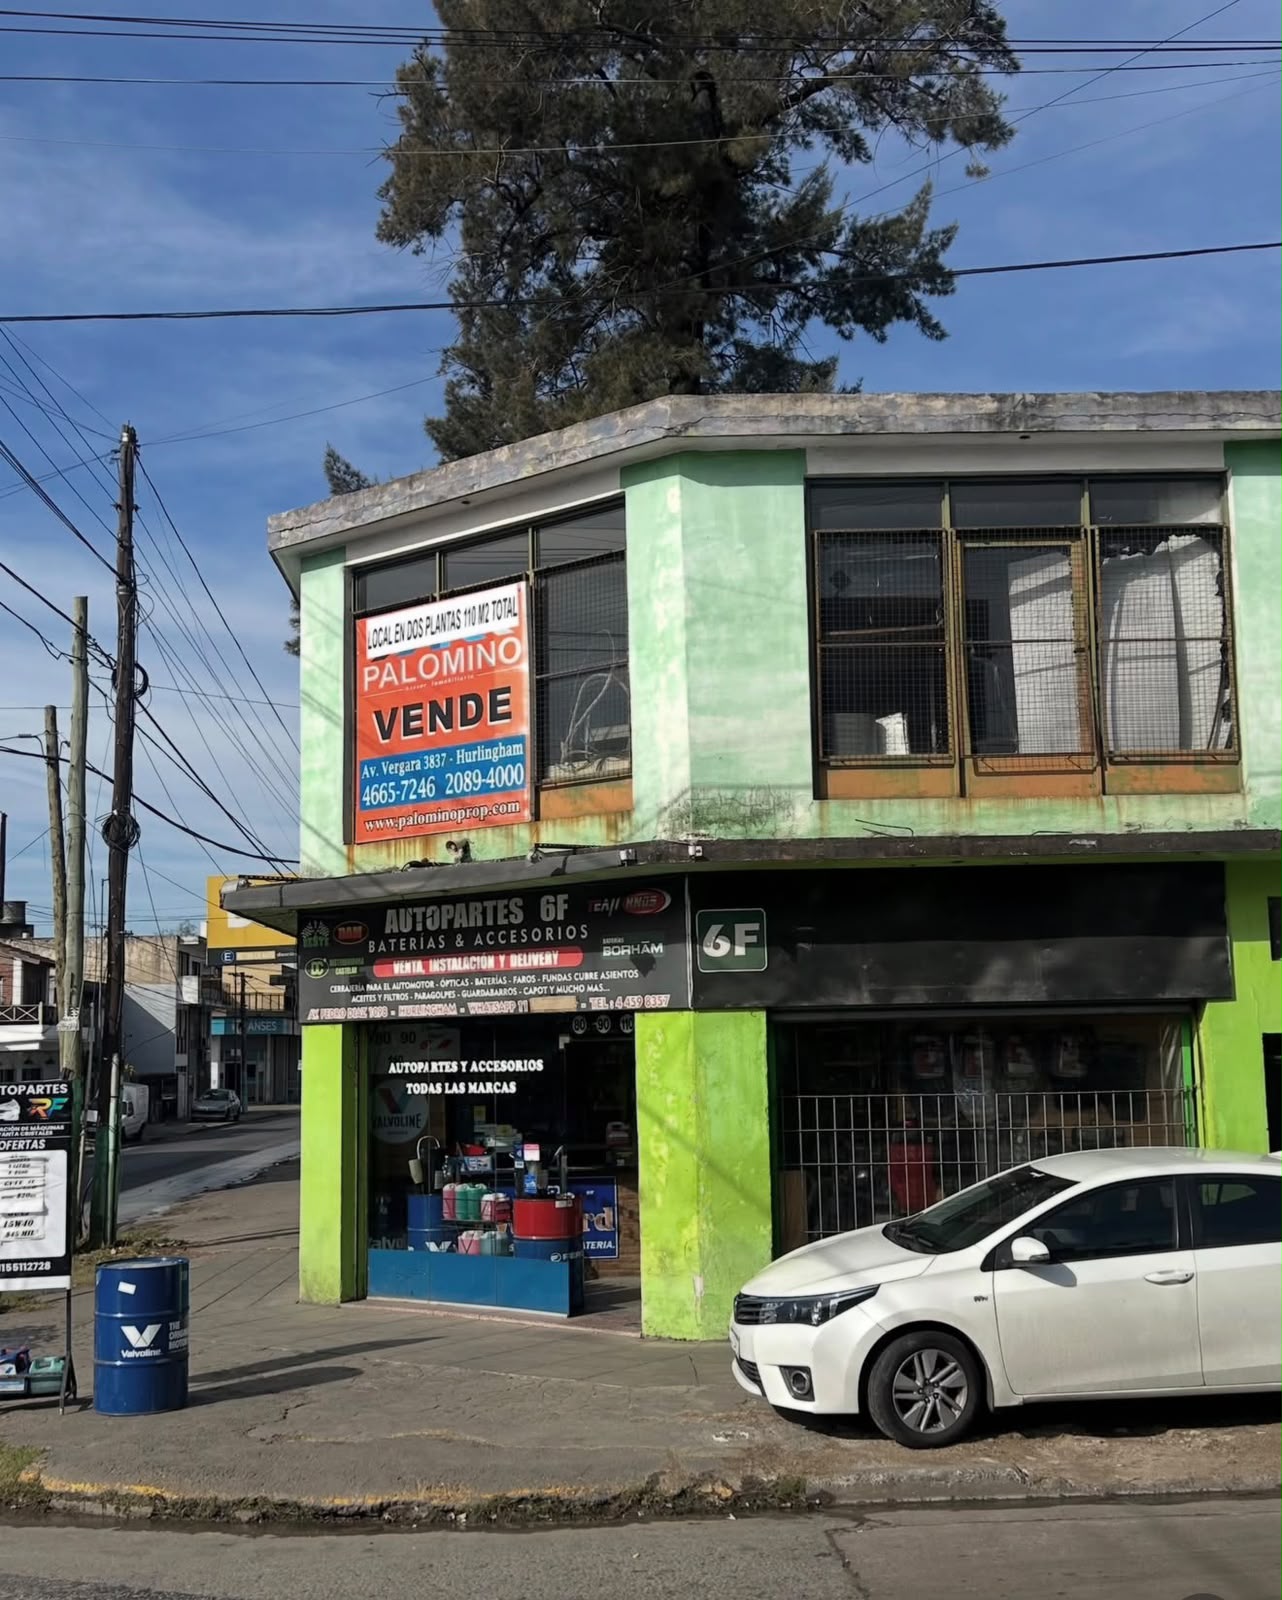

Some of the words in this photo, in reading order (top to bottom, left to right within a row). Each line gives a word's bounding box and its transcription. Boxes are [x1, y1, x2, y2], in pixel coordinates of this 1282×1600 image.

[368, 626, 392, 649] LOCAL
[394, 624, 405, 643] EN
[407, 618, 424, 640] DOS
[425, 609, 461, 638] PLANTAS
[464, 606, 476, 627] 110
[479, 604, 489, 625] M2
[492, 596, 518, 622] TOTAL
[363, 636, 522, 692] PALOMINO
[372, 686, 512, 743] VENDE
[361, 765, 379, 779] Av.
[381, 759, 421, 777] Vergara
[424, 753, 447, 770] 3837
[456, 743, 524, 765] Hurlingham
[362, 776, 436, 806] 4665-7246
[445, 763, 524, 795] 2089-4000
[364, 801, 520, 831] www.palominoprop.com
[384, 897, 524, 934] AUTOPARTES
[540, 894, 569, 922] 6F
[368, 932, 446, 953] BATERÍAS
[455, 934, 465, 947] &
[474, 924, 588, 946] ACCESORIOS
[702, 923, 760, 957] 6F
[429, 953, 495, 973] INSTALACIÓN
[499, 954, 506, 969] Y
[510, 950, 559, 969] DELIVERY
[351, 994, 376, 1003] ACEITES
[377, 993, 382, 1002] Y
[383, 992, 409, 1001] FILTROS
[414, 990, 456, 1000] PARAGOLPES
[461, 988, 517, 998] GUARDABARROS
[523, 986, 548, 995] CAPOT
[549, 985, 554, 994] Y
[556, 984, 585, 993] MUCHO
[366, 982, 382, 991] PARA
[383, 982, 391, 990] EL
[391, 980, 434, 990] AUTOMOTOR
[440, 978, 469, 988] ÓPTICAS
[474, 975, 507, 986] BATERÍAS
[513, 975, 536, 984] FAROS
[542, 973, 572, 982] FUNDAS
[573, 972, 598, 981] CUBRE
[600, 969, 639, 980] ASIENTOS
[320, 1007, 346, 1019] PEDRO
[368, 1006, 388, 1018] 1098
[398, 1003, 457, 1017] HURLINGHAM
[467, 1000, 517, 1014] WHATSAPP
[644, 994, 670, 1008] 8357
[247, 1021, 277, 1031] ANSES
[388, 1061, 458, 1074] AUTOPARTES
[460, 1060, 468, 1073] Y
[470, 1059, 544, 1073] ACCESORIOS
[406, 1082, 442, 1095] TODAS
[444, 1082, 466, 1094] LAS
[468, 1081, 517, 1094] MARCAS
[0, 1139, 46, 1150] OFERTAS
[121, 1349, 161, 1358] Valvoline
